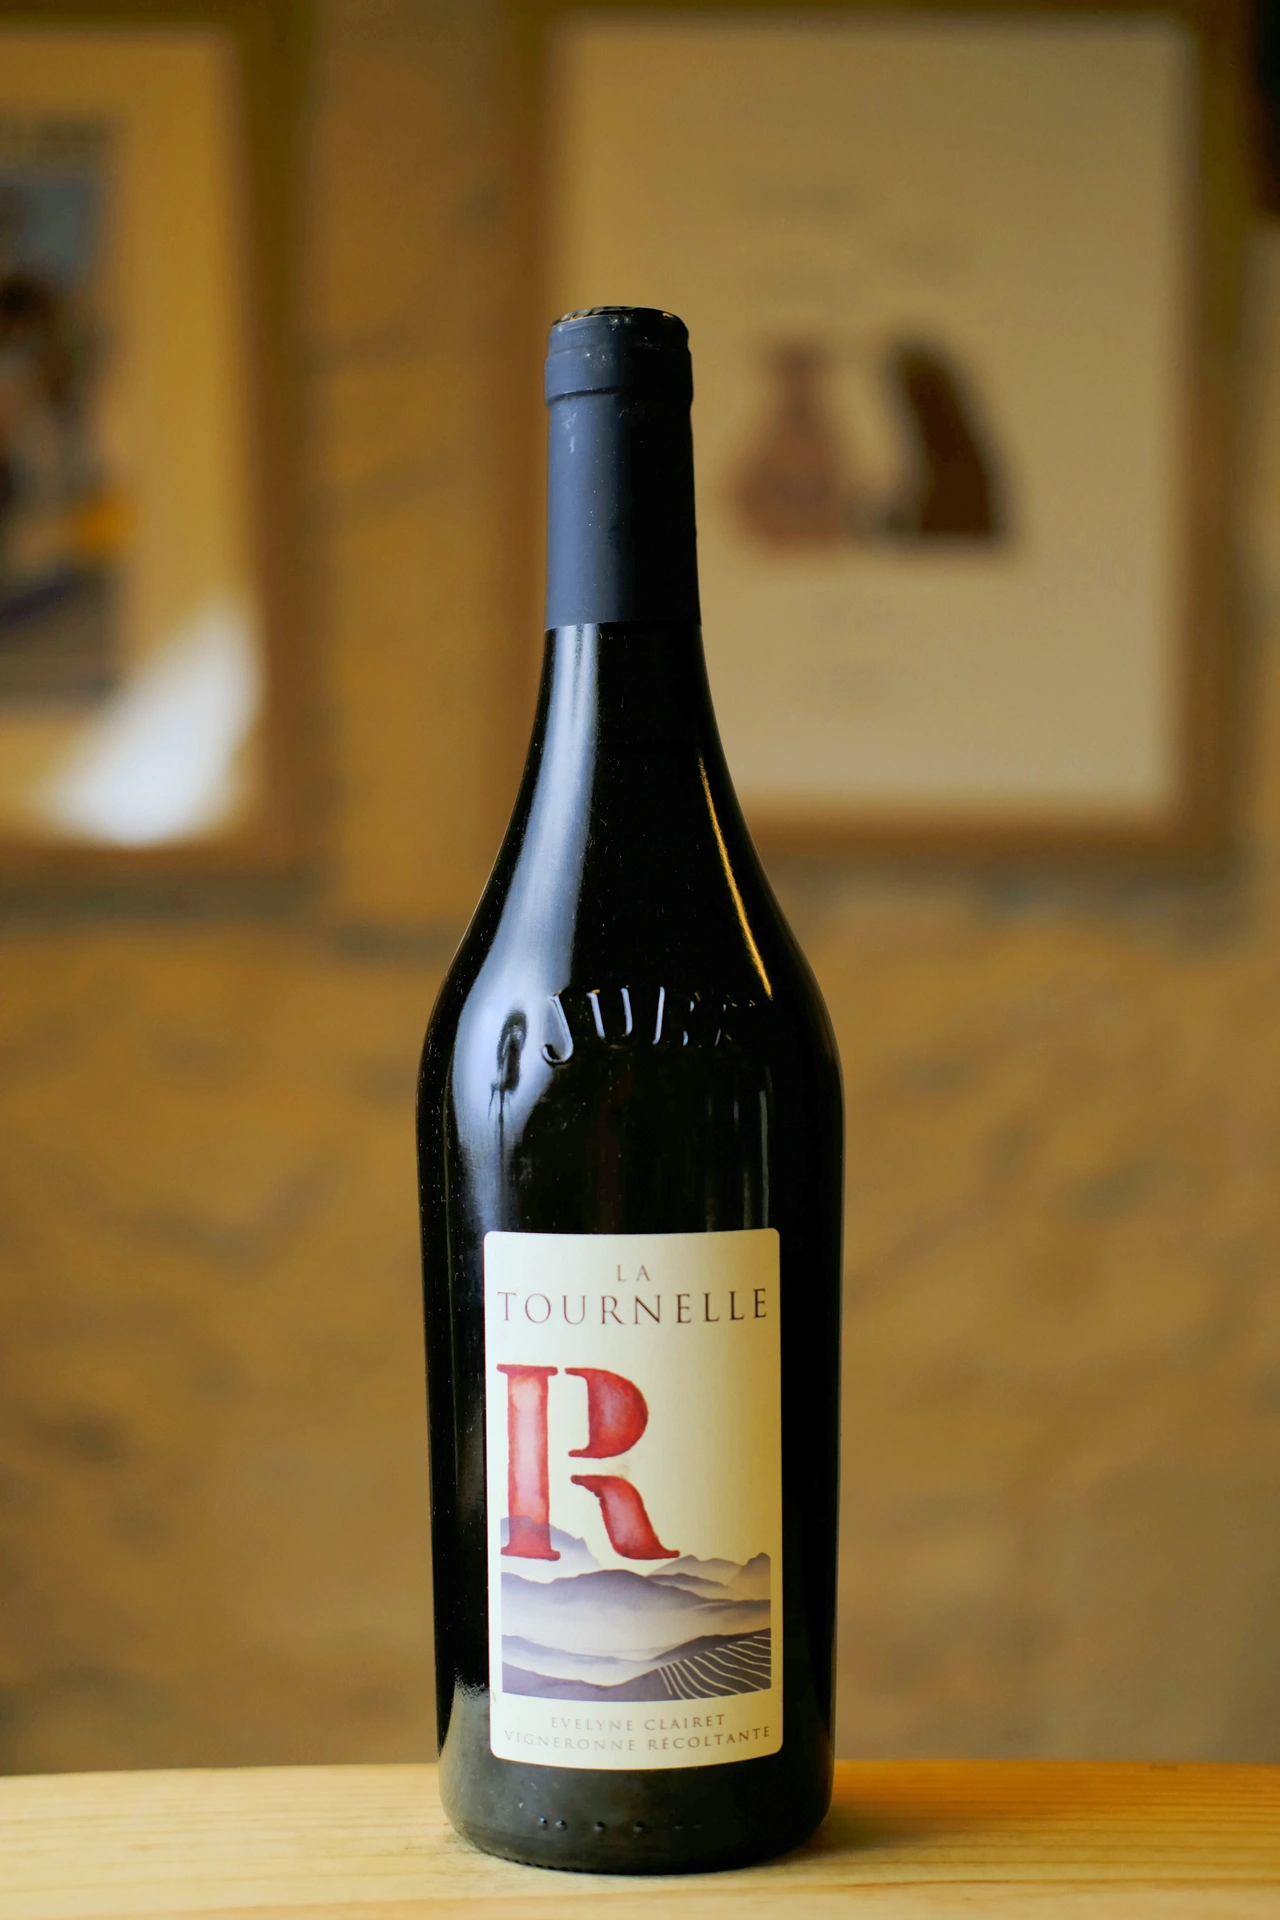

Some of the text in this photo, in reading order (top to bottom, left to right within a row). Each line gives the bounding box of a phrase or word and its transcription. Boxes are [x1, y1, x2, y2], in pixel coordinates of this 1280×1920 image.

[616, 1264, 651, 1282] LA
[497, 1288, 767, 1325] TOURNELLE
[496, 1363, 681, 1562] R
[551, 1714, 725, 1731] EVELYNE CLAIRET
[504, 1726, 770, 1751] VIGNERONNE RÉCOLTANTE
